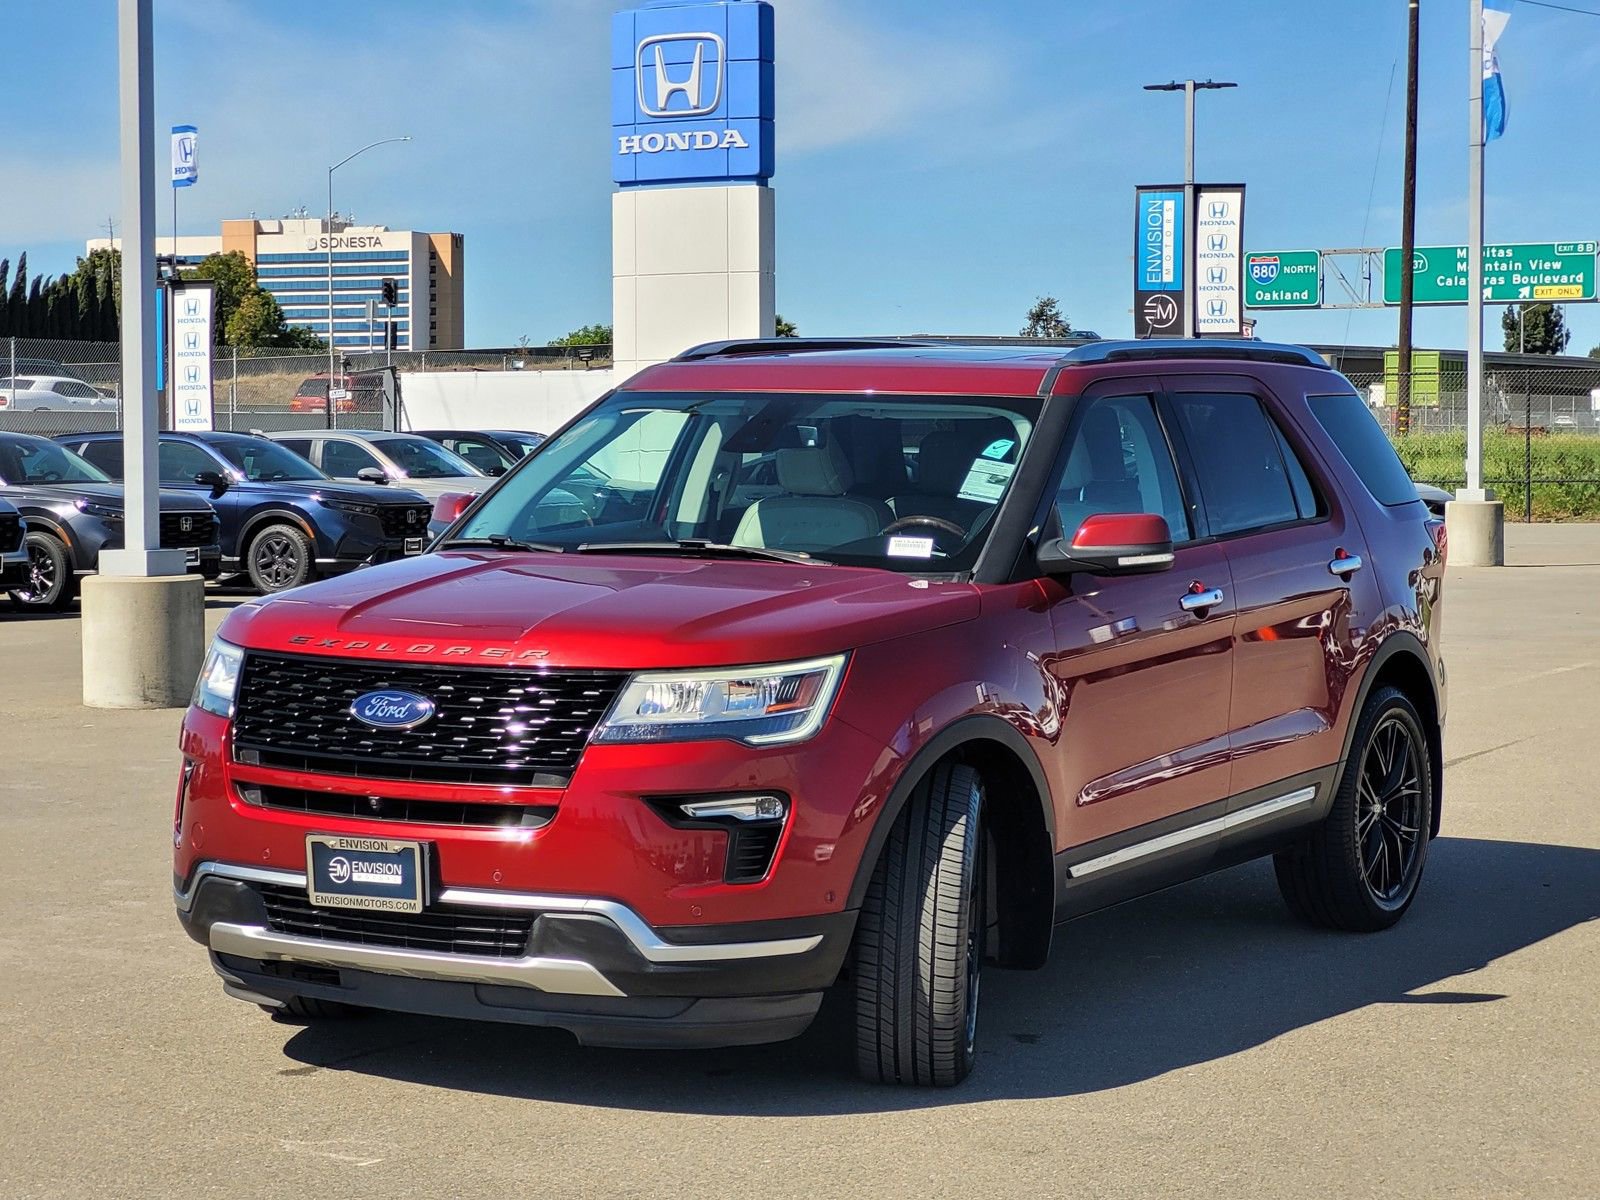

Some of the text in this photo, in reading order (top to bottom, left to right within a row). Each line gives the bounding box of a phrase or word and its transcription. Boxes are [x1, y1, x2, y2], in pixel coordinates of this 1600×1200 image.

[618, 129, 749, 155] HONDA
[319, 236, 383, 249] SONESTA
[1146, 200, 1163, 283] ENVISION
[1456, 247, 1513, 259] Mitas
[1252, 265, 1316, 278] 880 NORTH
[1412, 259, 1424, 270] 37
[1456, 259, 1562, 273] Mntain View
[1436, 272, 1584, 287] Calaras Boulevard
[1255, 289, 1309, 301] Oakland
[1535, 287, 1581, 296] EXIT ONLY
[288, 635, 552, 660] EXPLORER
[365, 695, 410, 719] Ford
[338, 838, 389, 851] ENVISION
[351, 861, 402, 875] ENVISION
[315, 895, 417, 912] ENVISIONMOTORS.COM
